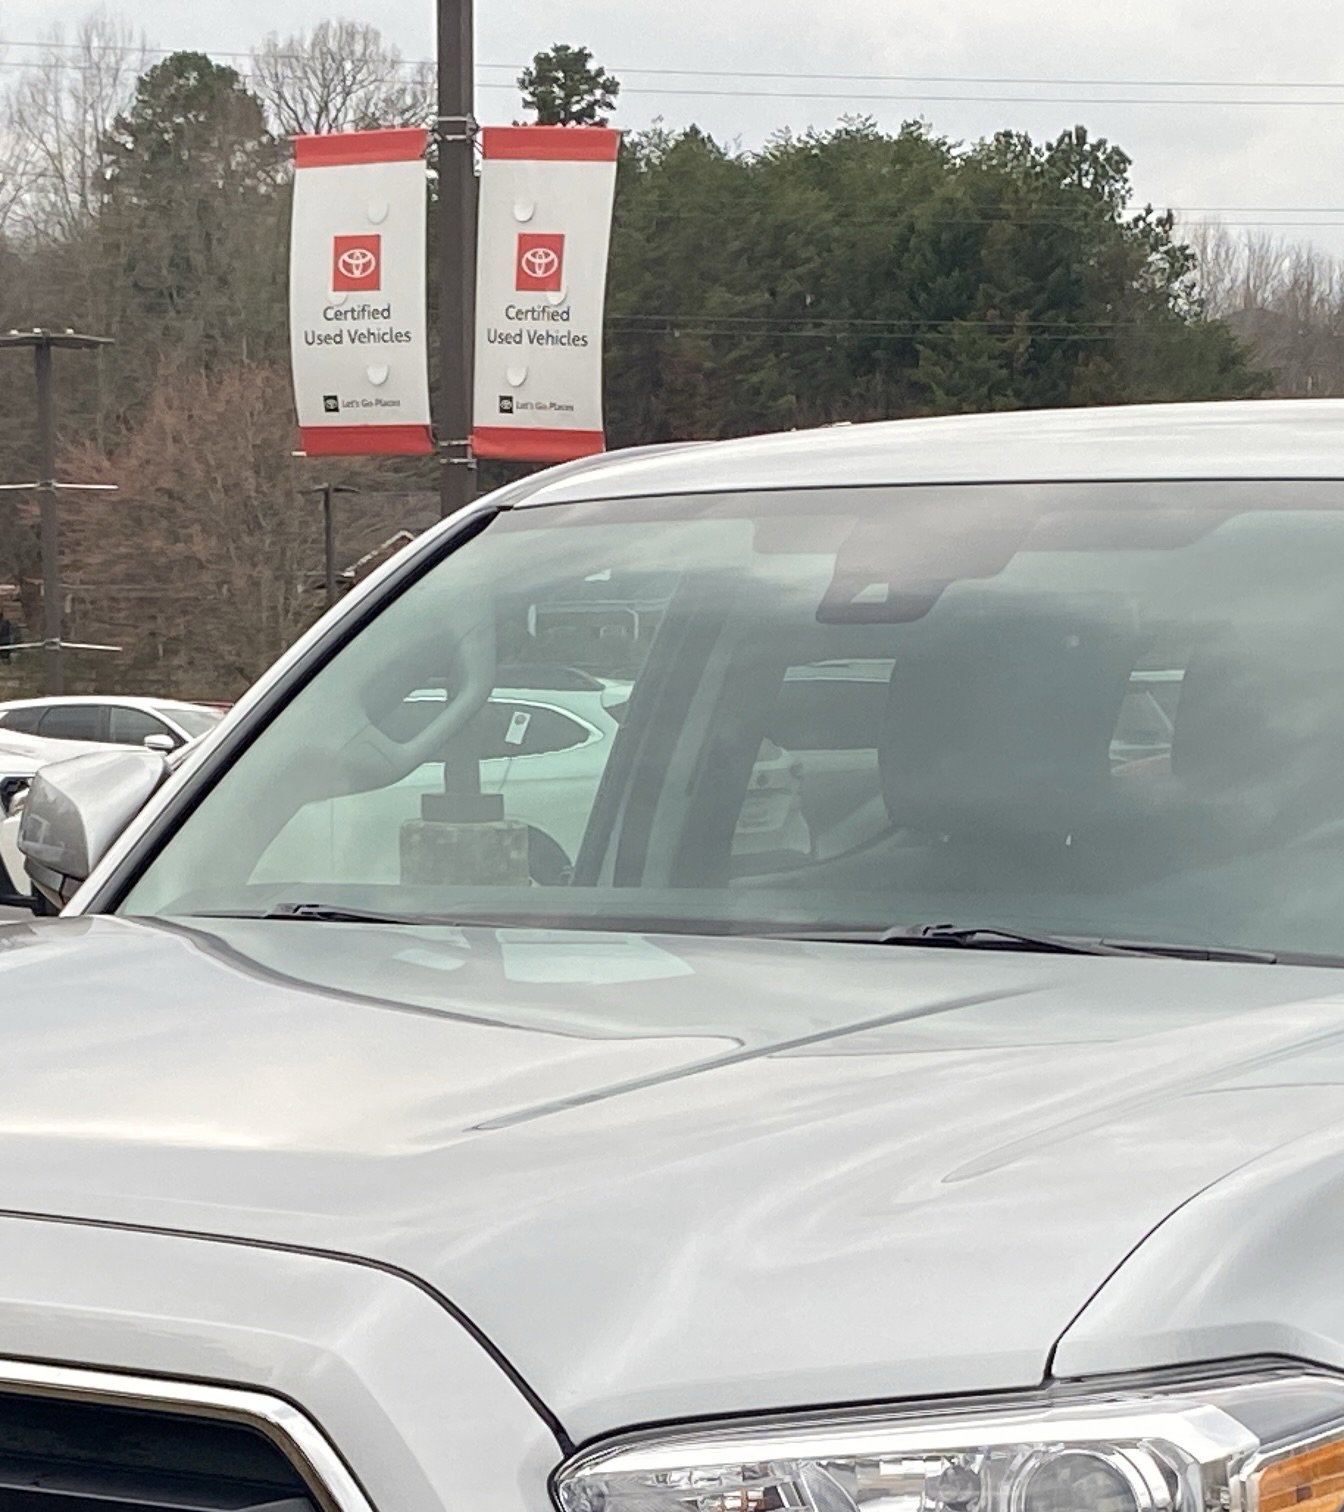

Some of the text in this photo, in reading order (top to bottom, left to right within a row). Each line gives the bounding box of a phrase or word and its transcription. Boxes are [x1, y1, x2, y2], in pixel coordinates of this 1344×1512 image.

[323, 303, 391, 321] Certified
[505, 304, 571, 322] Certified
[304, 326, 412, 346] Used Vehicles
[487, 328, 589, 347] Used Vehicles
